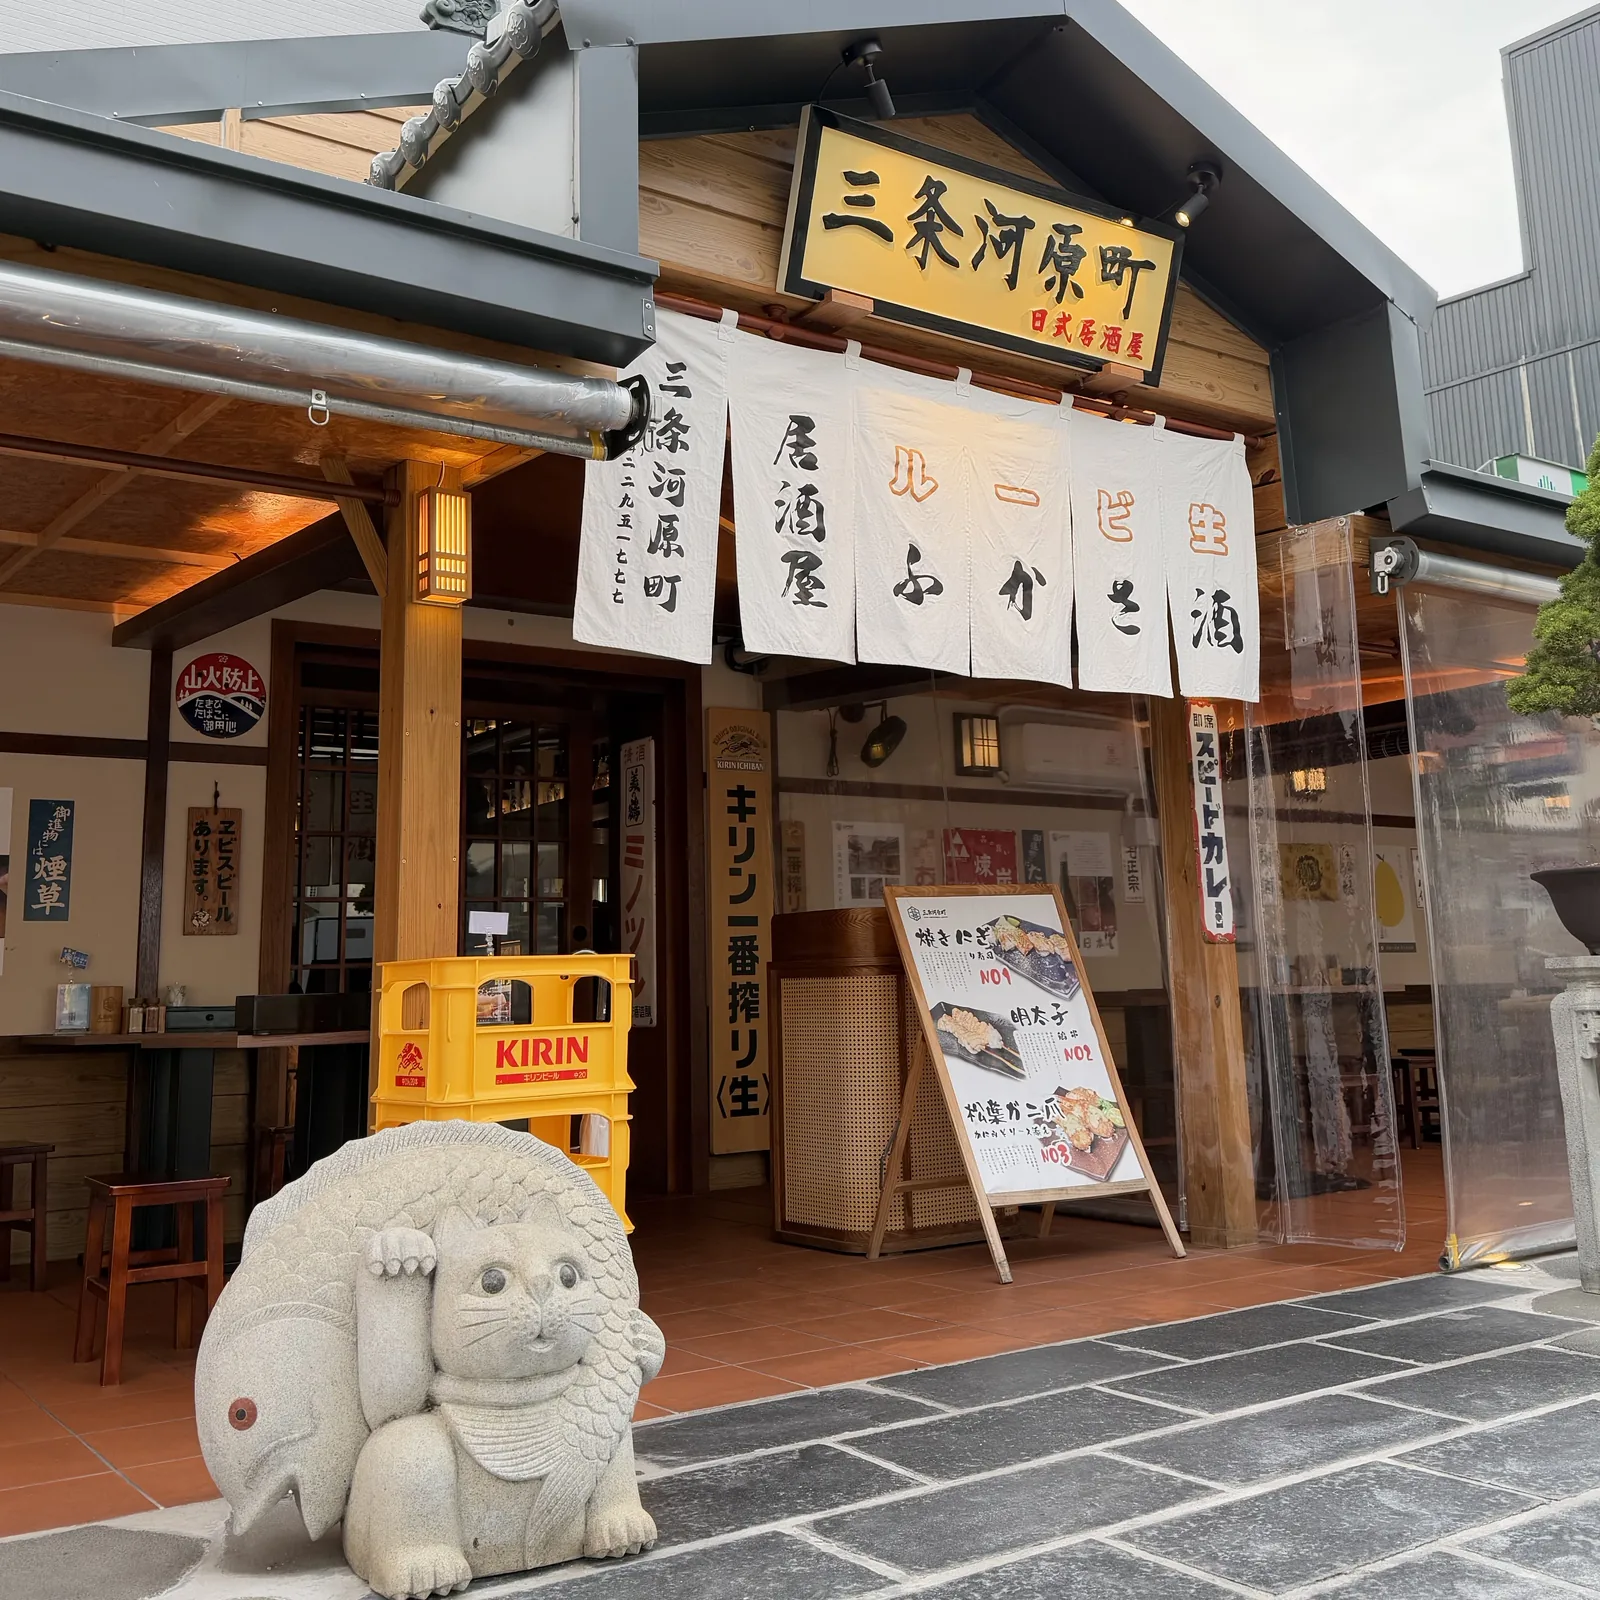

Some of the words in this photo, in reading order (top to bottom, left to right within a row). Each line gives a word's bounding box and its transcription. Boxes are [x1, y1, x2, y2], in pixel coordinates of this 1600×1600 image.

[823, 172, 1156, 320] 三条河原町
[1031, 309, 1144, 361] 日式居酒屋
[773, 415, 829, 609] 居酒屋
[184, 664, 260, 692] 山火防止
[194, 709, 229, 720] たばこに
[195, 698, 223, 708] たきび
[203, 720, 237, 733] 御用心
[1193, 713, 1214, 728] 即席
[192, 820, 211, 901] あります。
[31, 855, 67, 915] 煙草
[1010, 1003, 1068, 1026] 明太子
[495, 1035, 588, 1068] KIRIN
[1064, 1045, 1093, 1062] NO2
[523, 1072, 559, 1082] キリンビール
[1041, 1144, 1070, 1164] NO3
